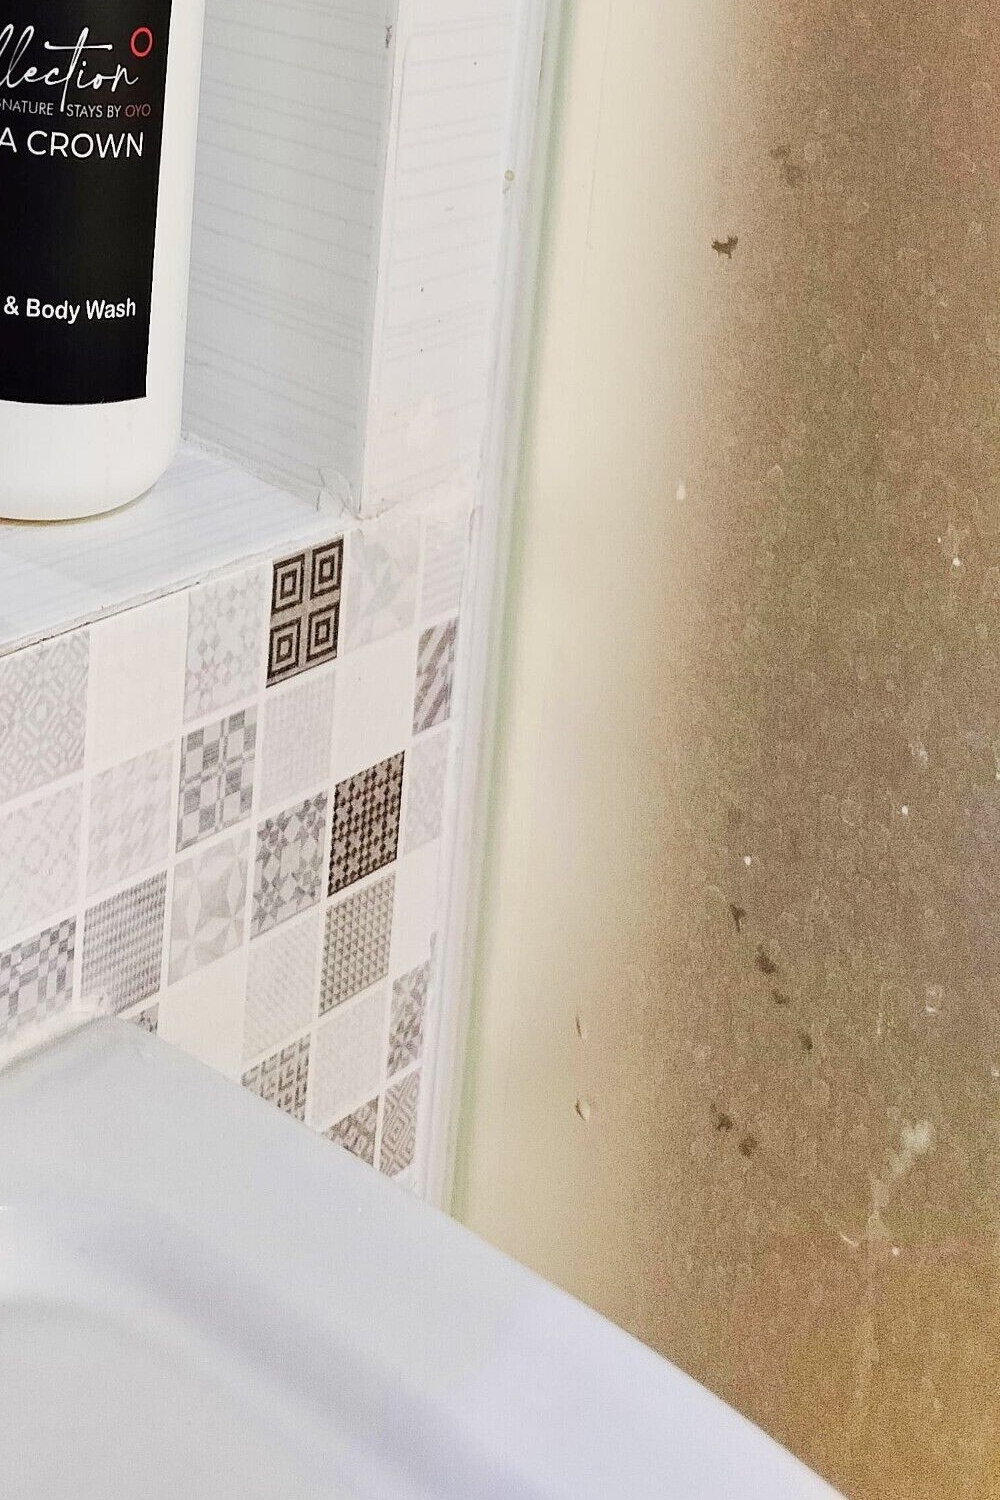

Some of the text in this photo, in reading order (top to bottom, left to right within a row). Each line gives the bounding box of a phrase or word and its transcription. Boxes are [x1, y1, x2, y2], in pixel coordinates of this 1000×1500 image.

[66, 103, 103, 118] STAYS
[106, 104, 122, 118] BY
[125, 103, 151, 117] OYO
[27, 130, 144, 158] CROWN
[3, 296, 19, 316] &
[26, 298, 80, 325] Body
[85, 298, 136, 320] Wash
